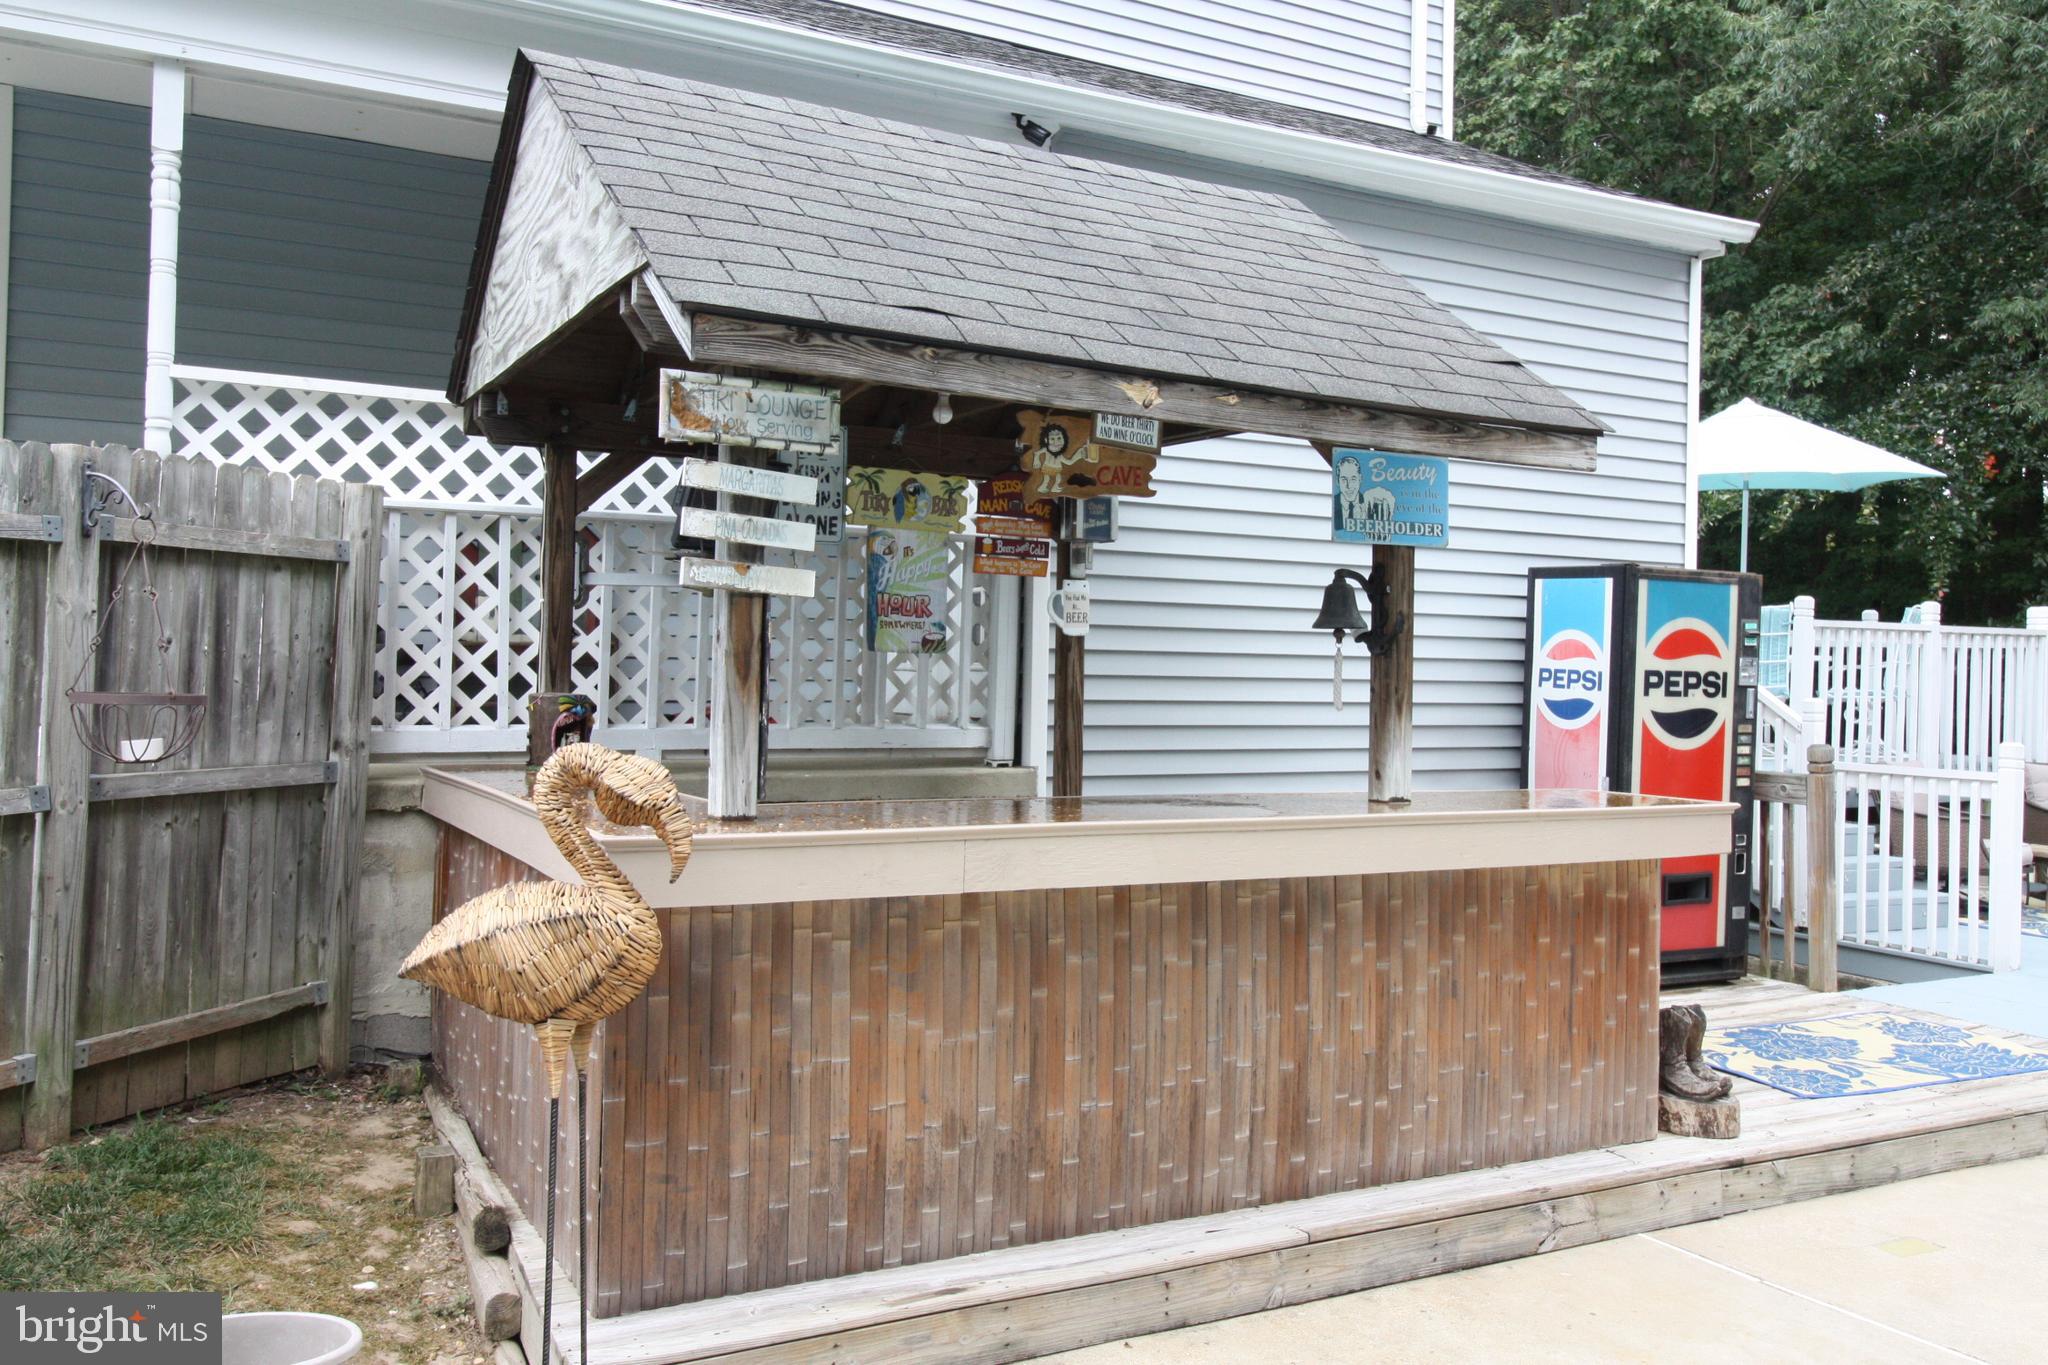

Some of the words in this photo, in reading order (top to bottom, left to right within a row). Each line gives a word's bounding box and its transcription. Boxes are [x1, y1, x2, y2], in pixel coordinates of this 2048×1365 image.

[745, 393, 827, 421] LOUNGE
[757, 419, 813, 440] Serving
[1110, 415, 1120, 426] DO
[1121, 416, 1135, 429] BEER
[1136, 418, 1155, 432] THIRTY
[1099, 426, 1112, 438] AND
[1113, 427, 1129, 441] WINE
[1129, 430, 1154, 446] O'CLOCK
[720, 466, 785, 496] MARGARITAS
[1096, 465, 1143, 487] CAVE
[1368, 457, 1438, 486] Beauty
[929, 494, 958, 517] BAR
[980, 499, 1009, 513] MAN
[1024, 502, 1052, 519] CAVE
[1345, 518, 1444, 538] BEERHOLDER
[996, 540, 1015, 553] Beers
[876, 559, 932, 592] Happy
[877, 592, 933, 619] HOUR
[1065, 611, 1088, 624] BEER
[1538, 668, 1603, 692] PEPSI
[1643, 670, 1728, 699] PEPSI
